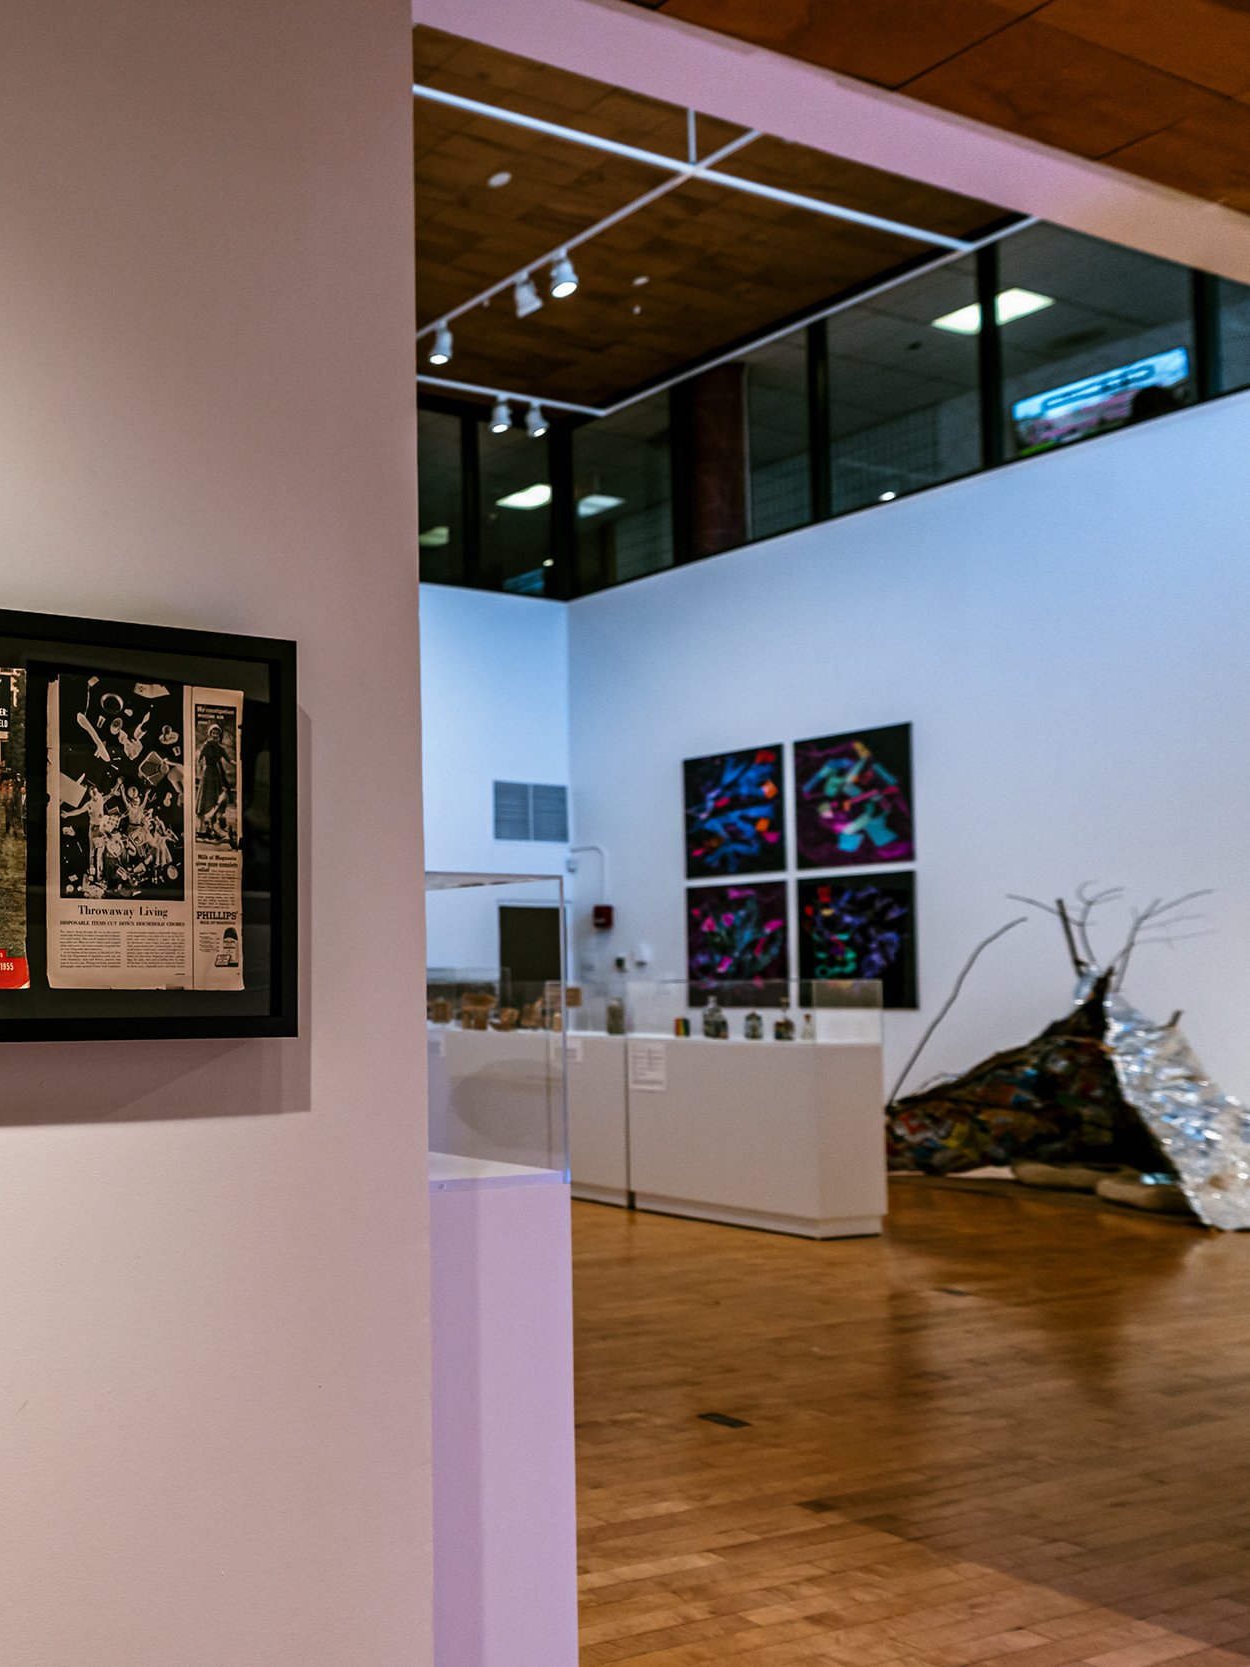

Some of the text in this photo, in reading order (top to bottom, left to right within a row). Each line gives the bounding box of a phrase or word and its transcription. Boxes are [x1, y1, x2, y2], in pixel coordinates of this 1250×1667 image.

[78, 905, 168, 919] Throwaway Living
[0, 962, 14, 971] 1955
